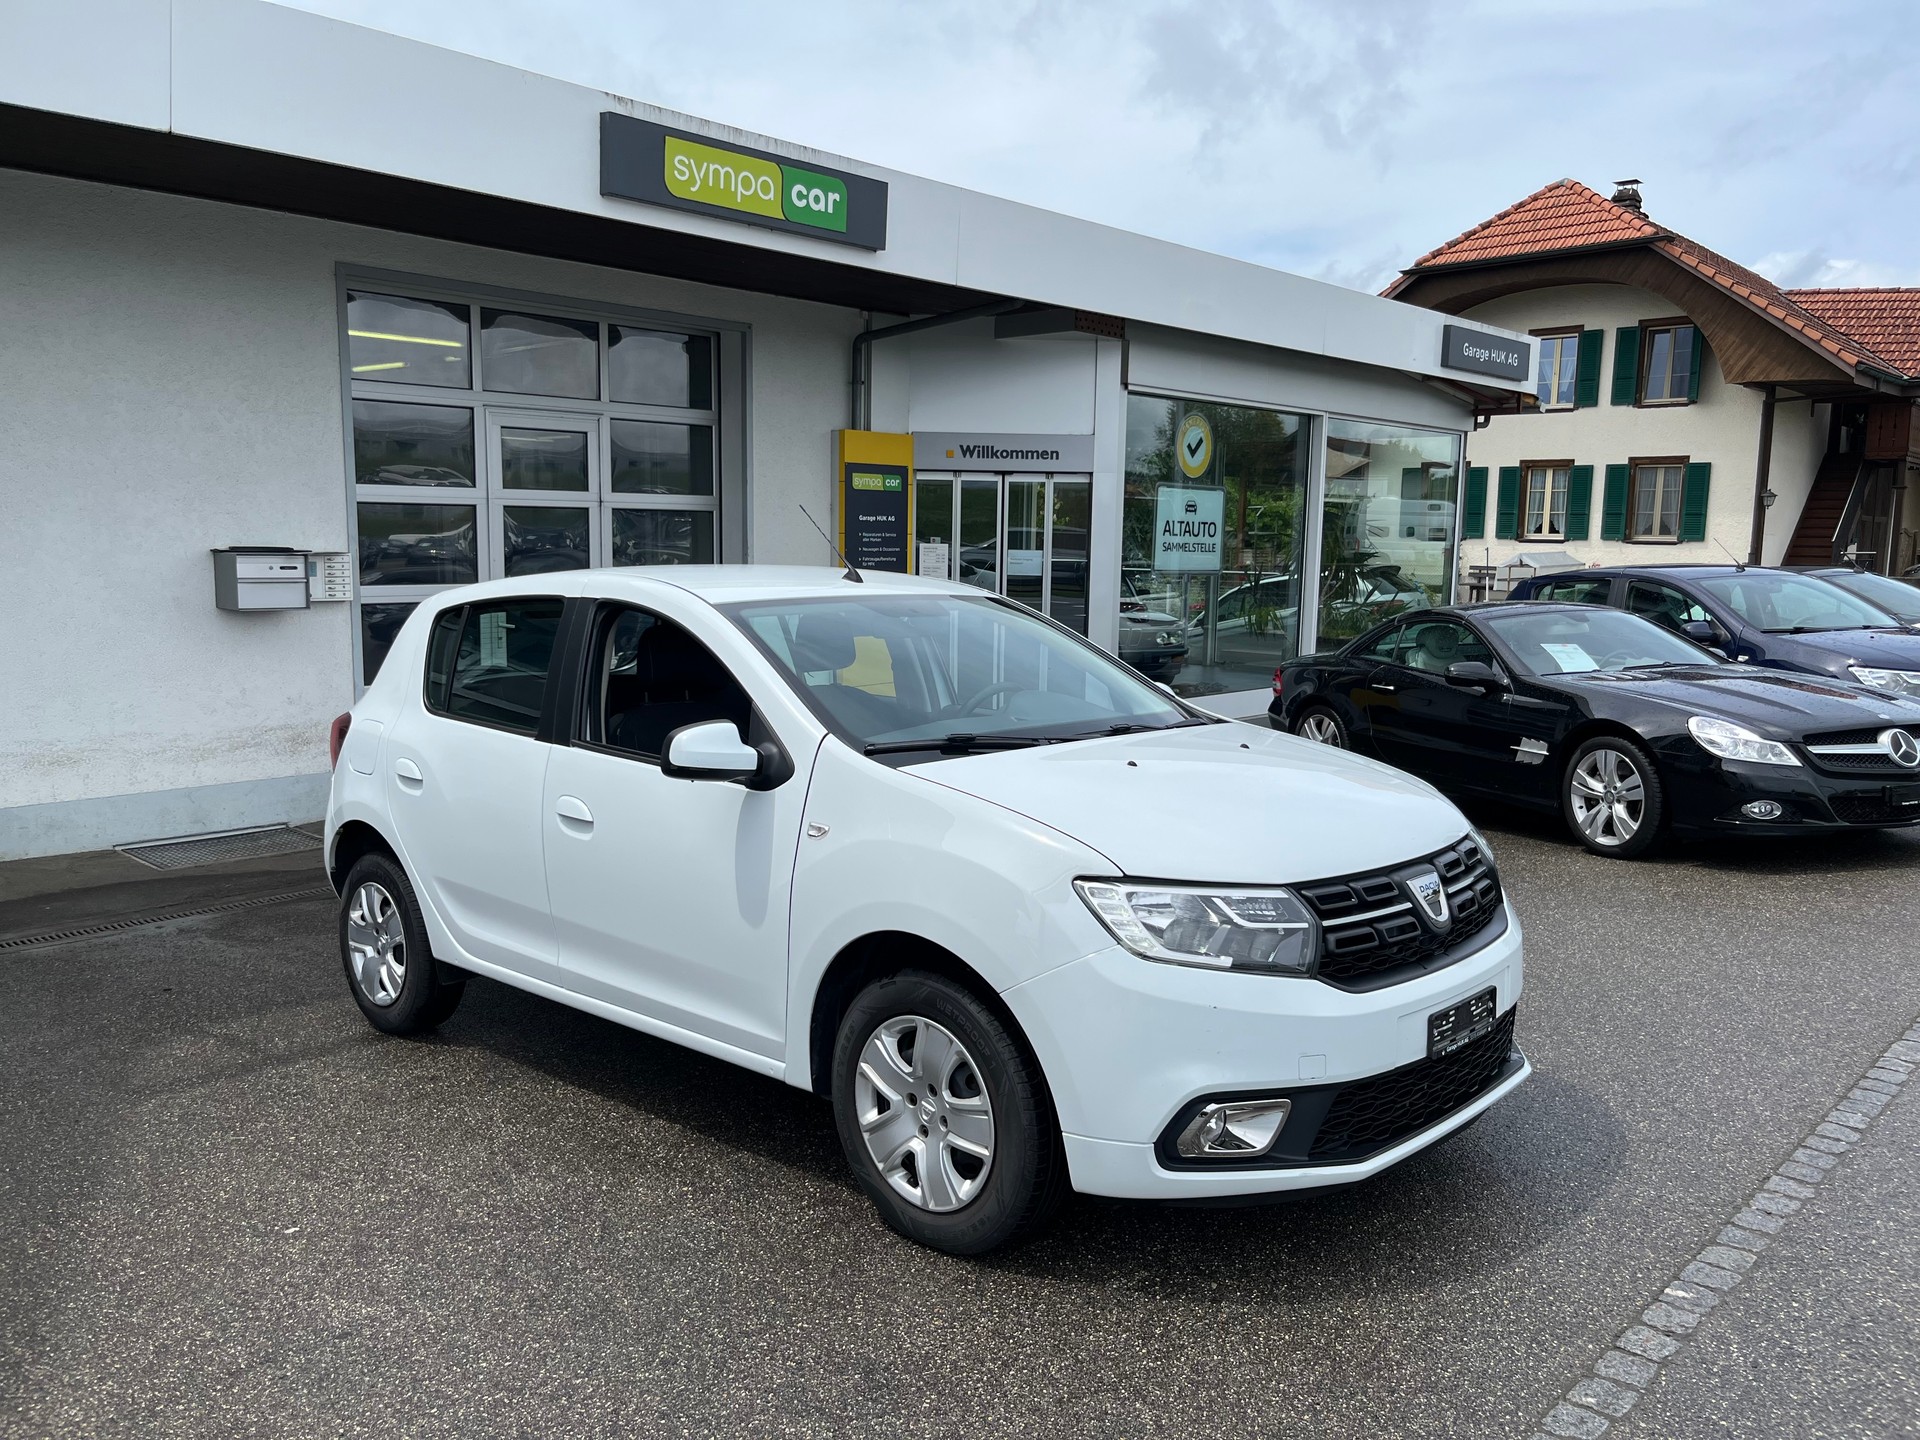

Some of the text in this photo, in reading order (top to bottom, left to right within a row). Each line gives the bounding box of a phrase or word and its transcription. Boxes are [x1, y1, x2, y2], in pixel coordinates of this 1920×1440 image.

[673, 155, 840, 214] sympa car
[1463, 342, 1518, 367] Garage HUK AG
[959, 444, 1060, 461] Willkommen
[854, 477, 900, 488] sympa car
[1162, 519, 1217, 538] ALTAUTO
[1162, 541, 1216, 553] SAMMELSTELLE
[1418, 880, 1440, 893] DACIA
[935, 998, 991, 1056] WETPROOF
